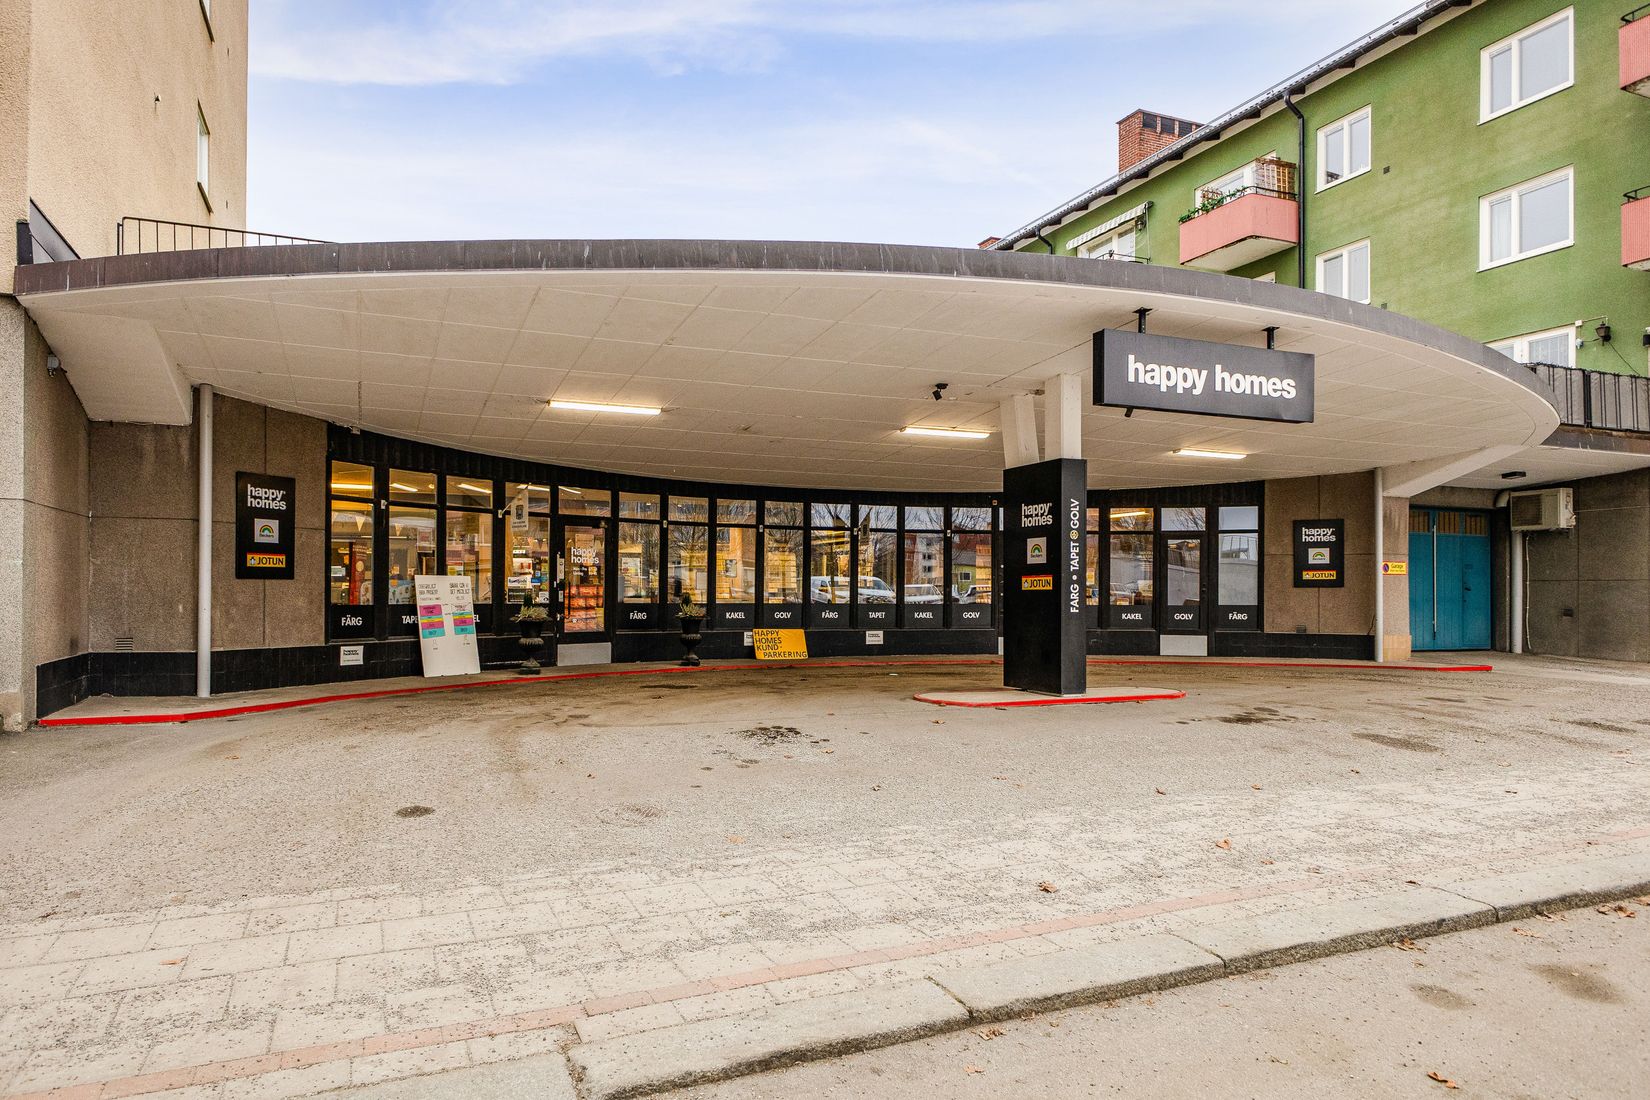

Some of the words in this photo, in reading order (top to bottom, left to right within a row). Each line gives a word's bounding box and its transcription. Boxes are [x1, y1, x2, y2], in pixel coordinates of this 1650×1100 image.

[1128, 354, 1208, 396] happy
[1215, 364, 1297, 400] homes
[247, 483, 284, 501] happy
[247, 496, 286, 510] homes
[1021, 503, 1050, 517] happy
[1070, 498, 1079, 529] GOLV
[1021, 514, 1052, 527] homes
[1302, 527, 1333, 536] happy
[1302, 534, 1336, 542] homes
[571, 547, 597, 558] happy
[1070, 541, 1079, 571] TAPET
[257, 556, 284, 566] JOTUN
[571, 556, 599, 564] homes
[1029, 577, 1051, 588] JOTUN
[629, 611, 647, 620] FÄRG
[821, 610, 839, 619] FÄRG
[1228, 612, 1248, 620] FÄRG
[341, 615, 363, 626] FÄRG
[401, 615, 420, 625] TAPE
[755, 637, 782, 645] HOMES
[763, 651, 808, 659] PARKERING
